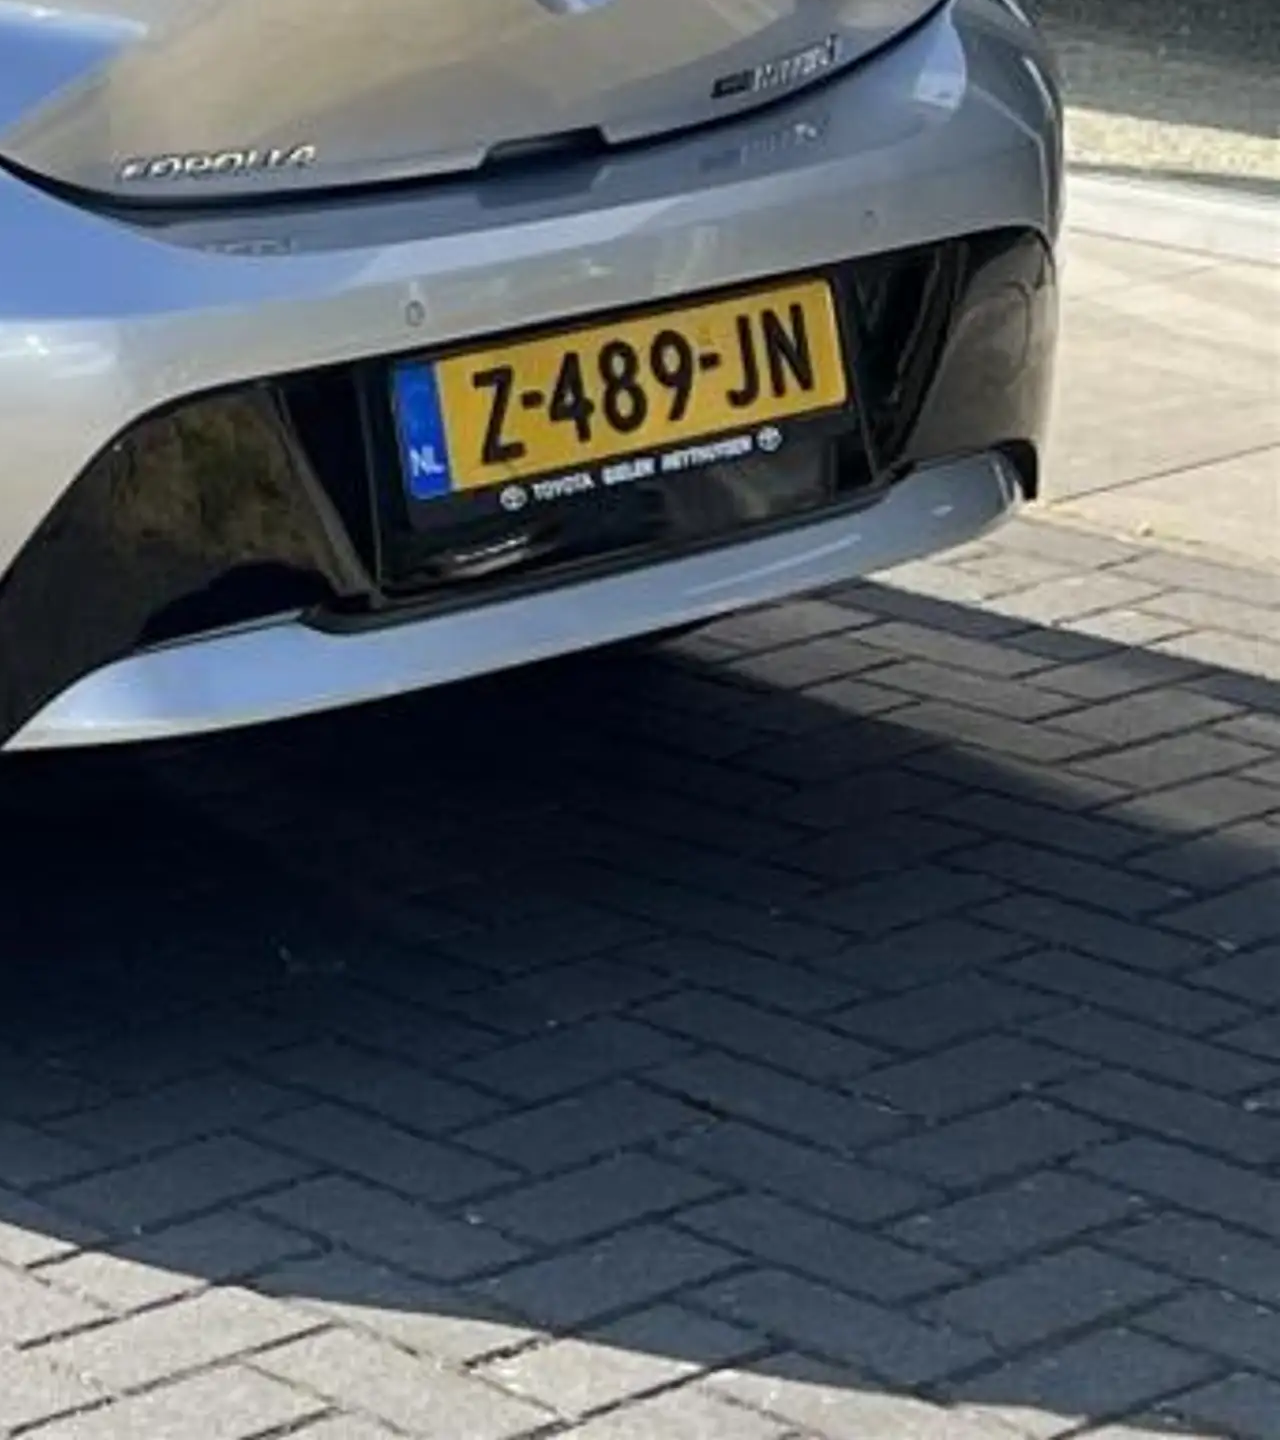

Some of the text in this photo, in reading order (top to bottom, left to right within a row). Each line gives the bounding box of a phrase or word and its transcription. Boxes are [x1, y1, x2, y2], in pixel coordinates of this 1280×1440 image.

[408, 303, 815, 477] NL Z-489-JN
[531, 471, 595, 501] TOYOTA
